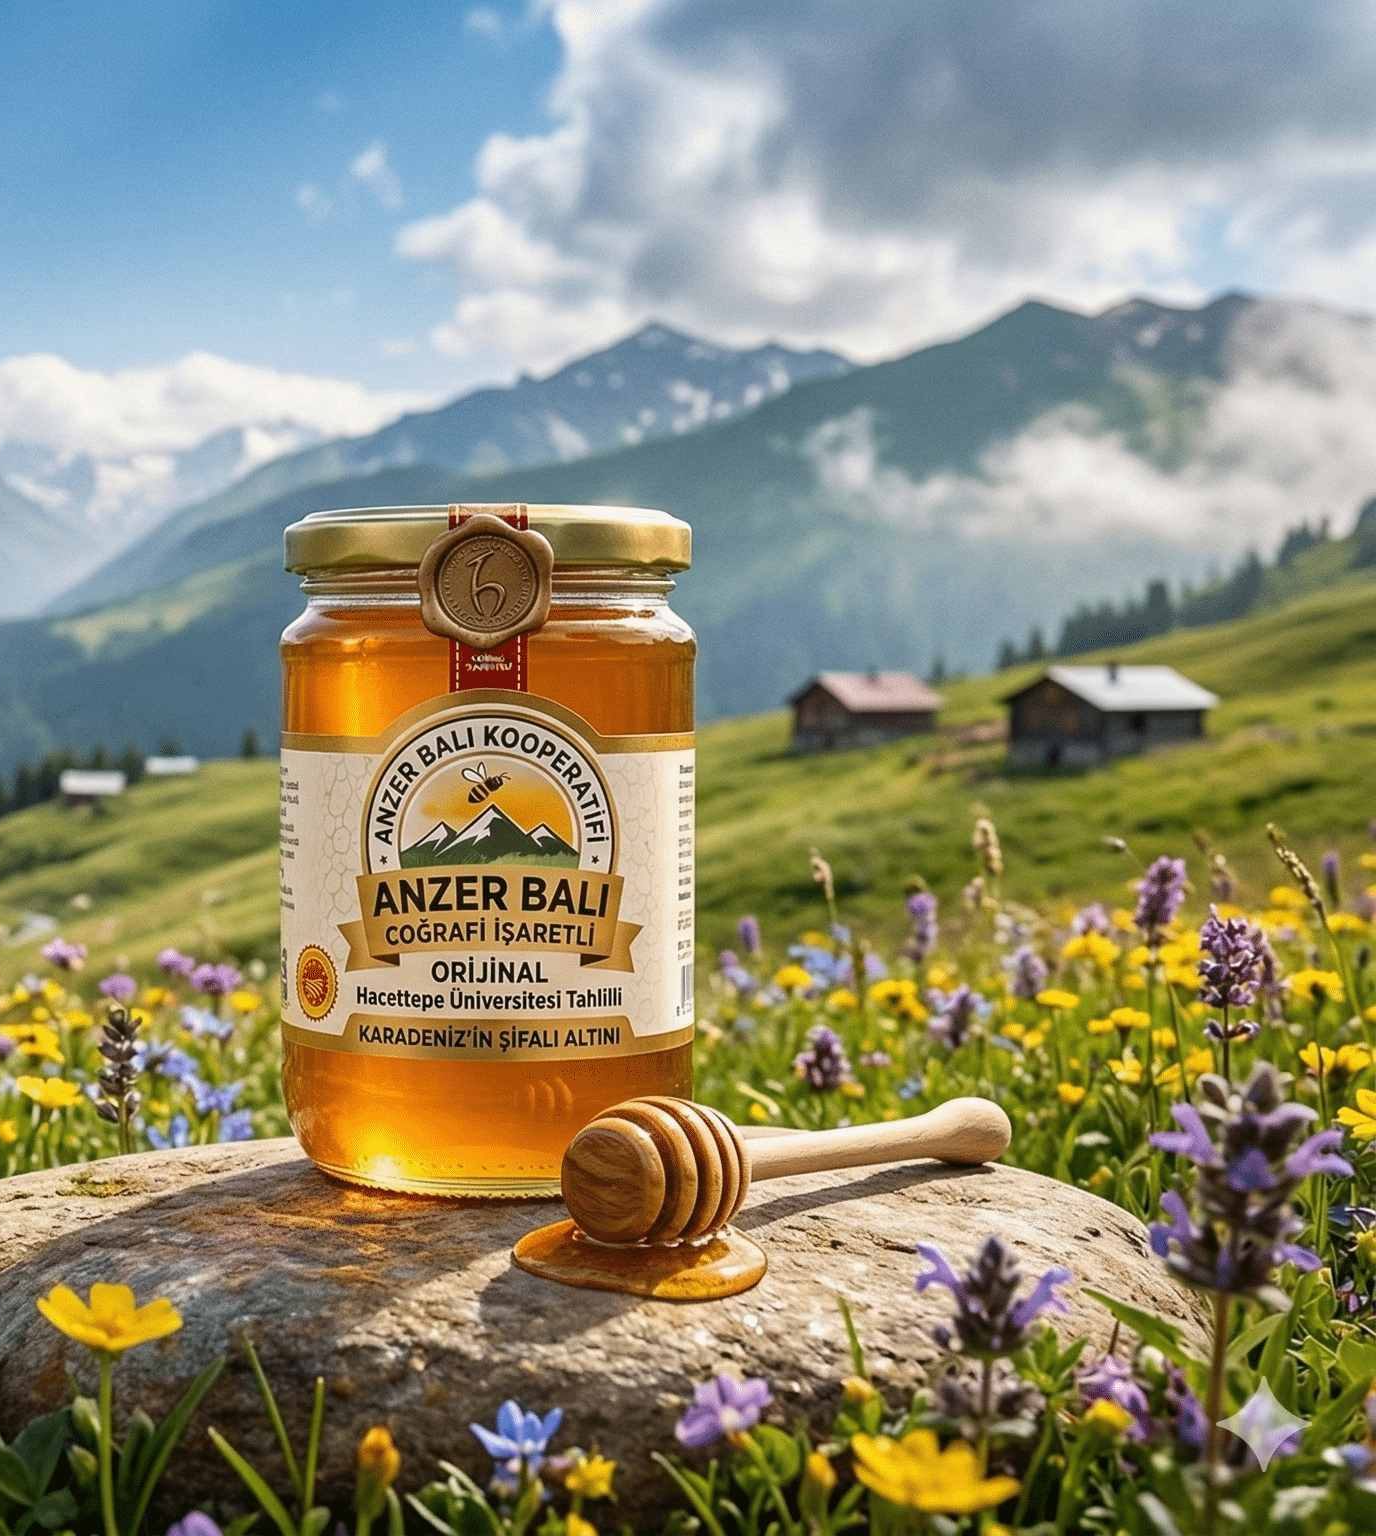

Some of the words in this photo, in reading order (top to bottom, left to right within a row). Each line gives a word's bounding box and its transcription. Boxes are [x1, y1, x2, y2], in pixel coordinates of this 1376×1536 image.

[374, 761, 421, 846] ANZER
[416, 726, 474, 769] BALI
[483, 725, 610, 845] KOOPERATİFİ
[373, 875, 508, 917] ANZER
[521, 876, 610, 918] BALI
[385, 917, 486, 946] COĞRAFİ
[495, 918, 595, 947] İŞARETLİ
[431, 956, 549, 984] ORİJİNAL
[356, 986, 444, 1012] Hacettepe
[450, 987, 561, 1010] Üniversitesi
[566, 987, 622, 1008] Tahlilli
[359, 1024, 493, 1049] KARADENİZ'İN
[499, 1025, 559, 1052] ŞİFALI
[564, 1026, 620, 1048] ALTINI
